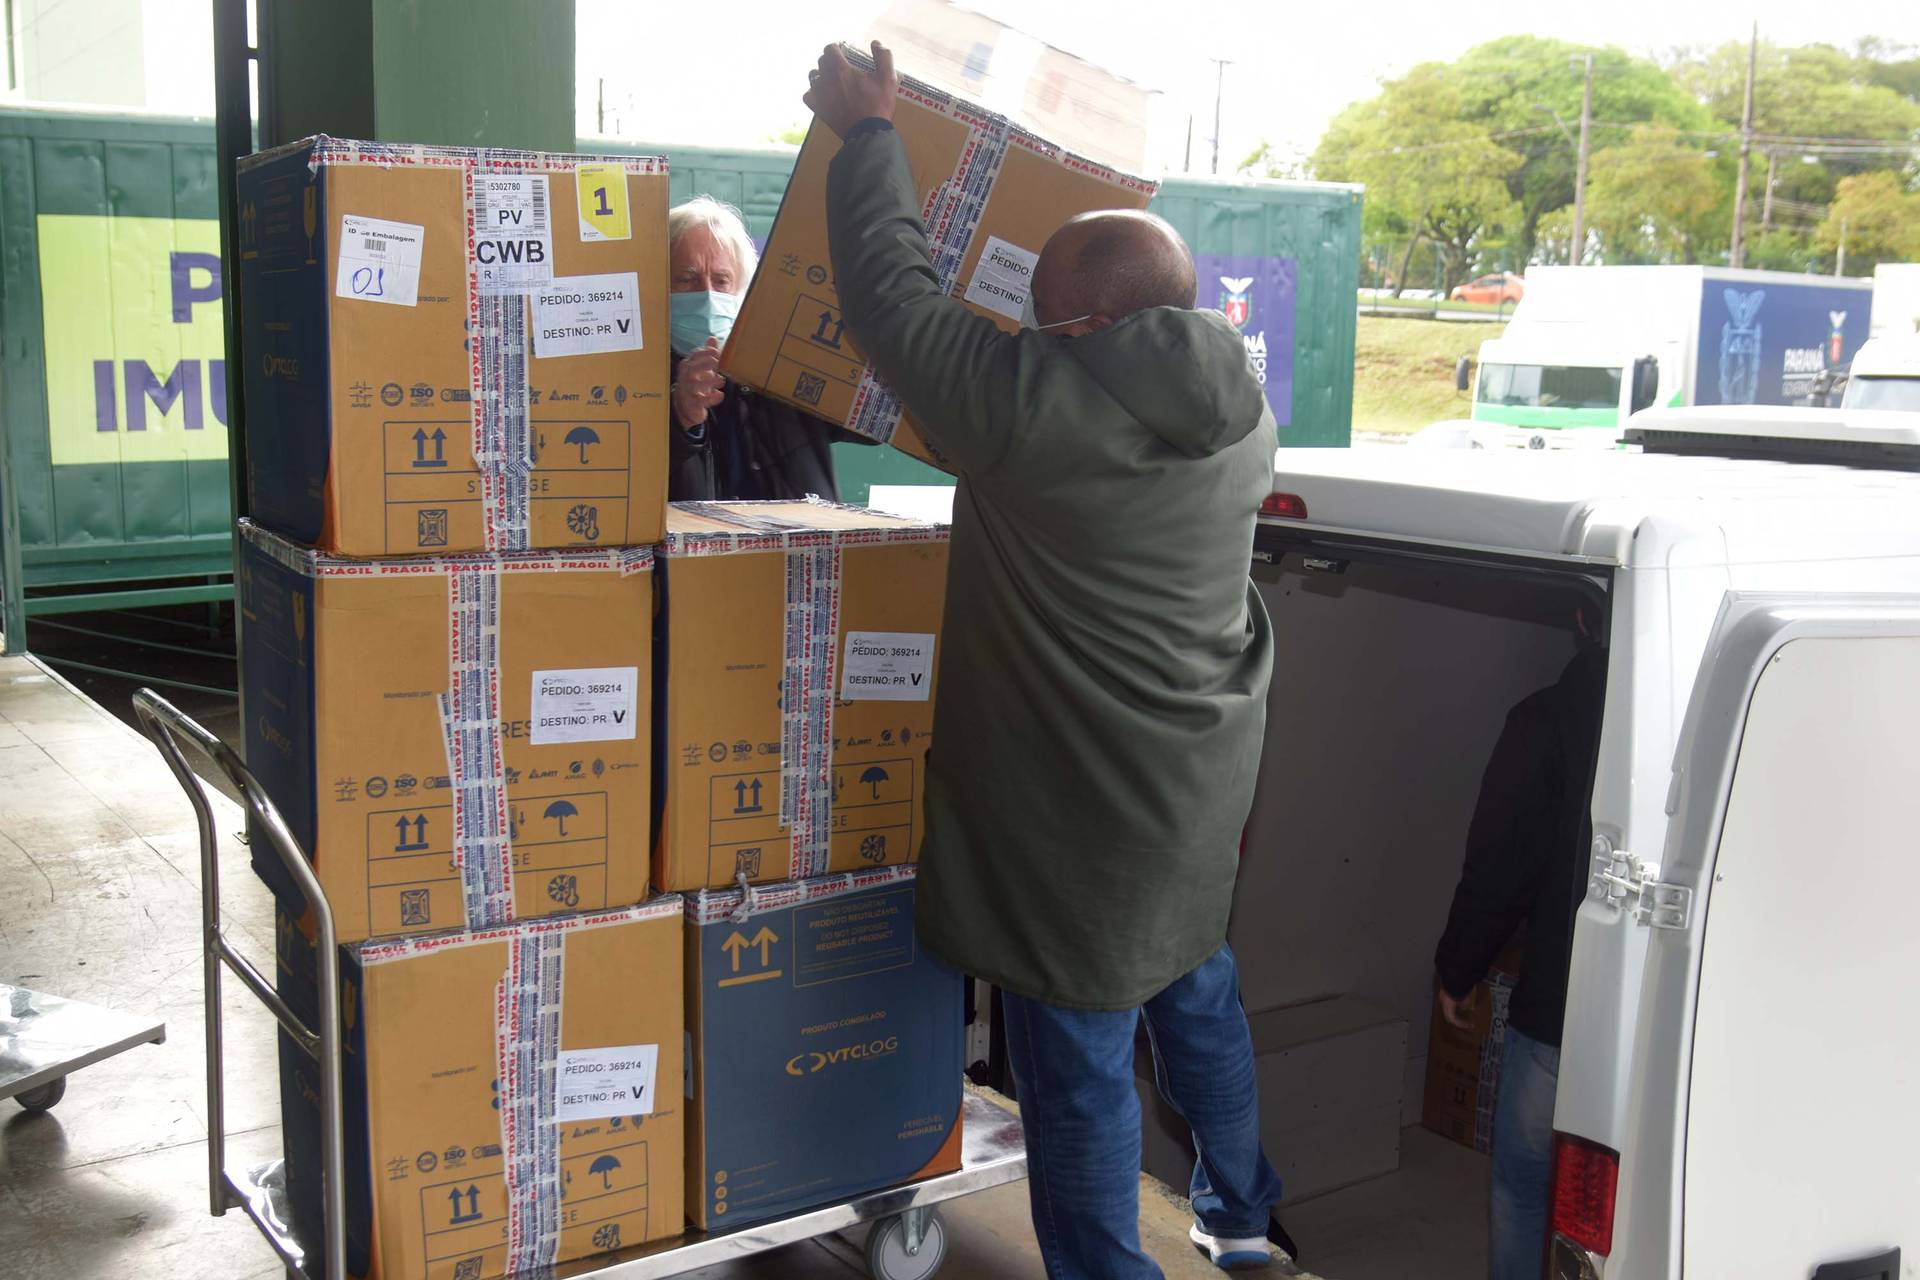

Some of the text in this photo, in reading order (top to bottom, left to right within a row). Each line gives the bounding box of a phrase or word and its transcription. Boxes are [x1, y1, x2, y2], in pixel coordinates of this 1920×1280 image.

[594, 187, 614, 216] 1
[499, 210, 522, 225] PV
[372, 232, 415, 242] Embalagem
[477, 240, 544, 264] CWB
[991, 254, 1031, 277] PEDIDO:
[540, 291, 623, 306] PEDIDO: 369214
[543, 319, 630, 339] DESTINO: PR V
[410, 388, 434, 397] ISO
[852, 647, 920, 656] PEDIDO: 369214
[850, 673, 922, 686] DESTINO: PR V
[541, 684, 622, 696] PEDIDO: 369214
[541, 710, 626, 727] DESTINO: PR V
[395, 778, 417, 788] ISO
[801, 1021, 839, 1035] PRODUTO
[826, 1036, 898, 1064] VTCLOG
[565, 1061, 641, 1074] PEDIDO: 369214
[563, 1085, 644, 1104] DESTINO: PR V
